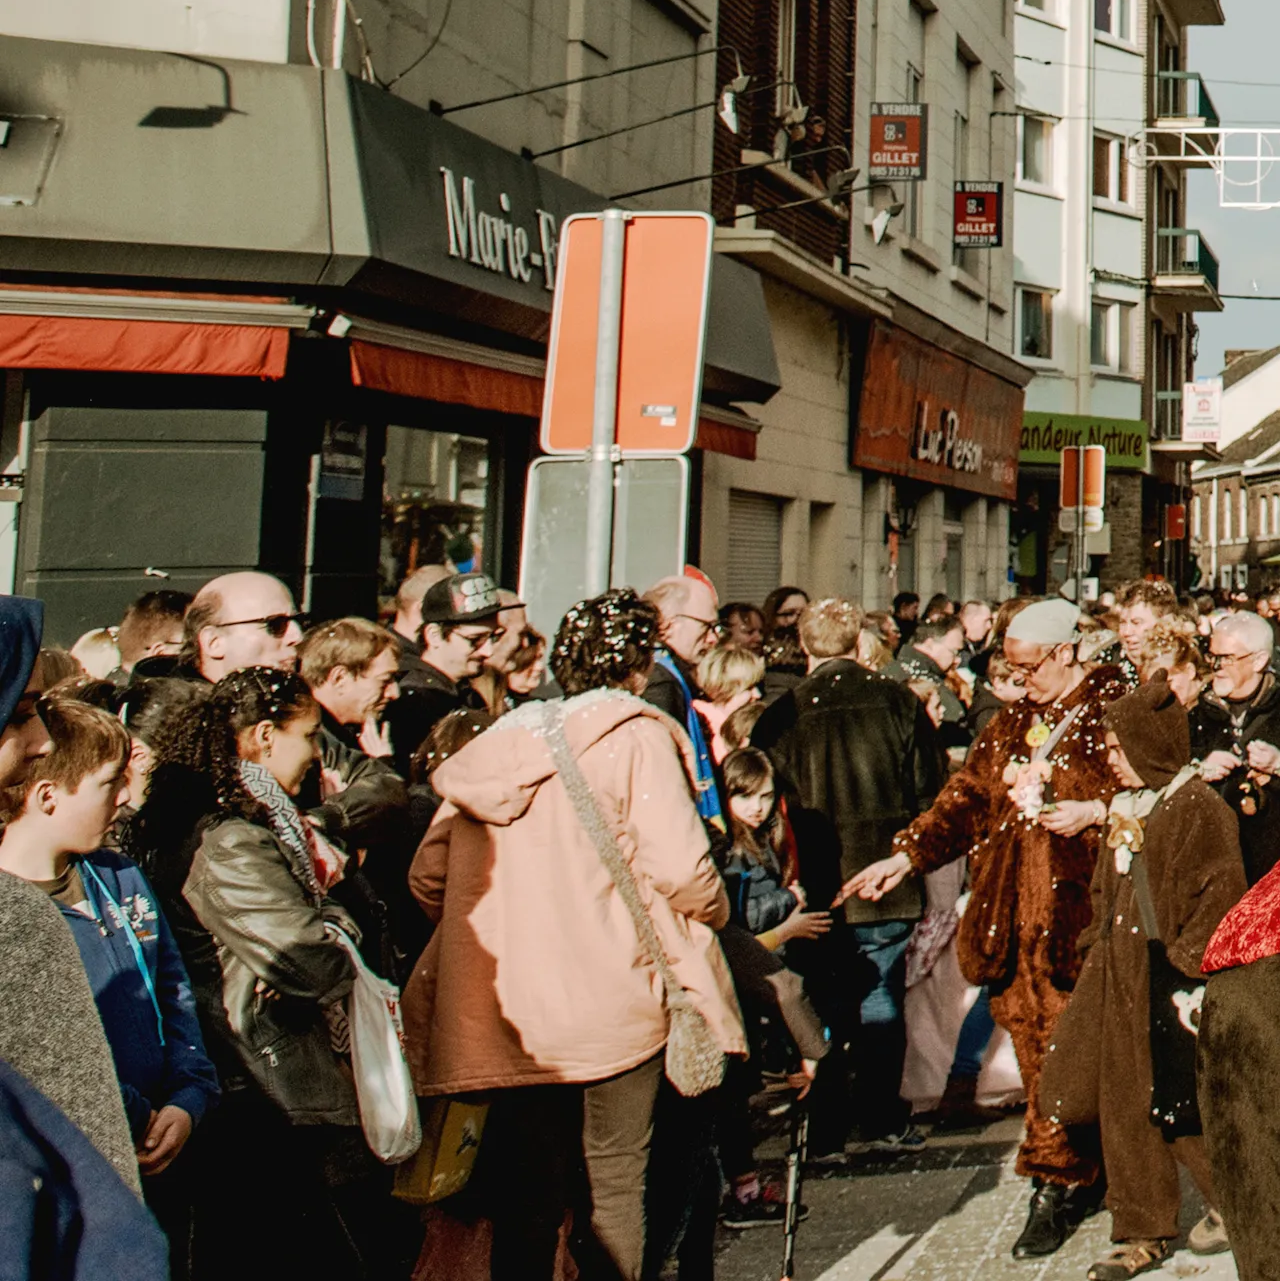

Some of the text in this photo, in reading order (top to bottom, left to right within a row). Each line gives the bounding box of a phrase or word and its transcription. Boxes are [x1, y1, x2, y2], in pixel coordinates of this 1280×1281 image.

[881, 104, 922, 116] VENDRE
[872, 151, 919, 164] GILLET
[964, 182, 998, 193] VENDRE
[439, 166, 560, 291] Marie-F
[956, 222, 997, 233] GILLET
[1020, 420, 1143, 457] andeur Nature
